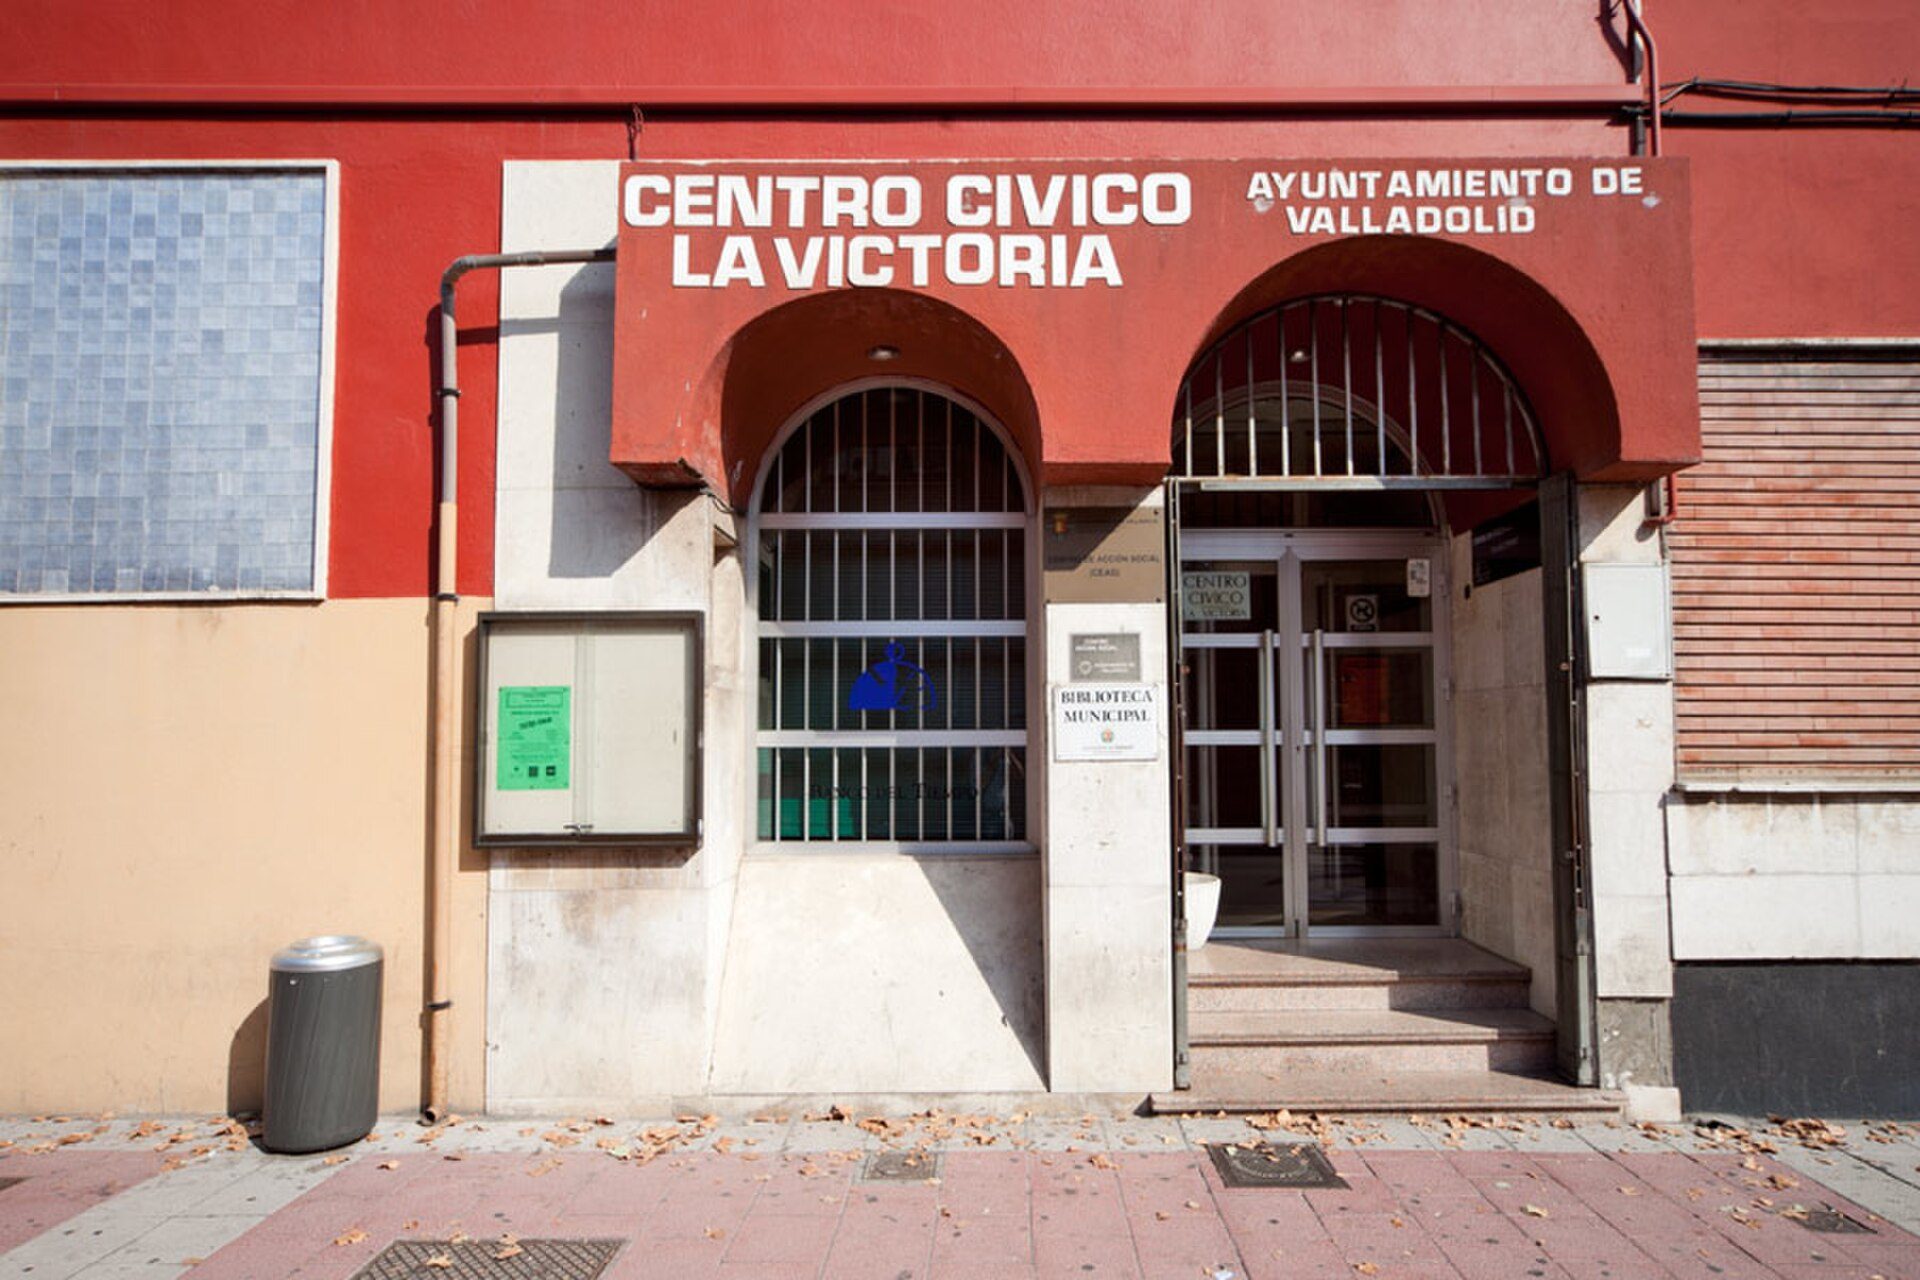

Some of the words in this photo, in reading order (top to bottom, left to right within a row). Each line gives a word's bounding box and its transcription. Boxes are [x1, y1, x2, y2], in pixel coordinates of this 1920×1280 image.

[1246, 167, 1574, 200] AYUNTAMIENTO
[1591, 167, 1644, 195] DE
[624, 174, 922, 227] CENTRO
[946, 172, 1192, 227] CIVICO
[1285, 204, 1536, 235] VALLADOLID
[672, 235, 766, 287] LA
[773, 233, 1124, 289] VICTORIA
[1183, 575, 1247, 588] CENTRO
[1061, 690, 1153, 704] BIBLIOTECA
[1063, 709, 1151, 722] MUNICIPAL
